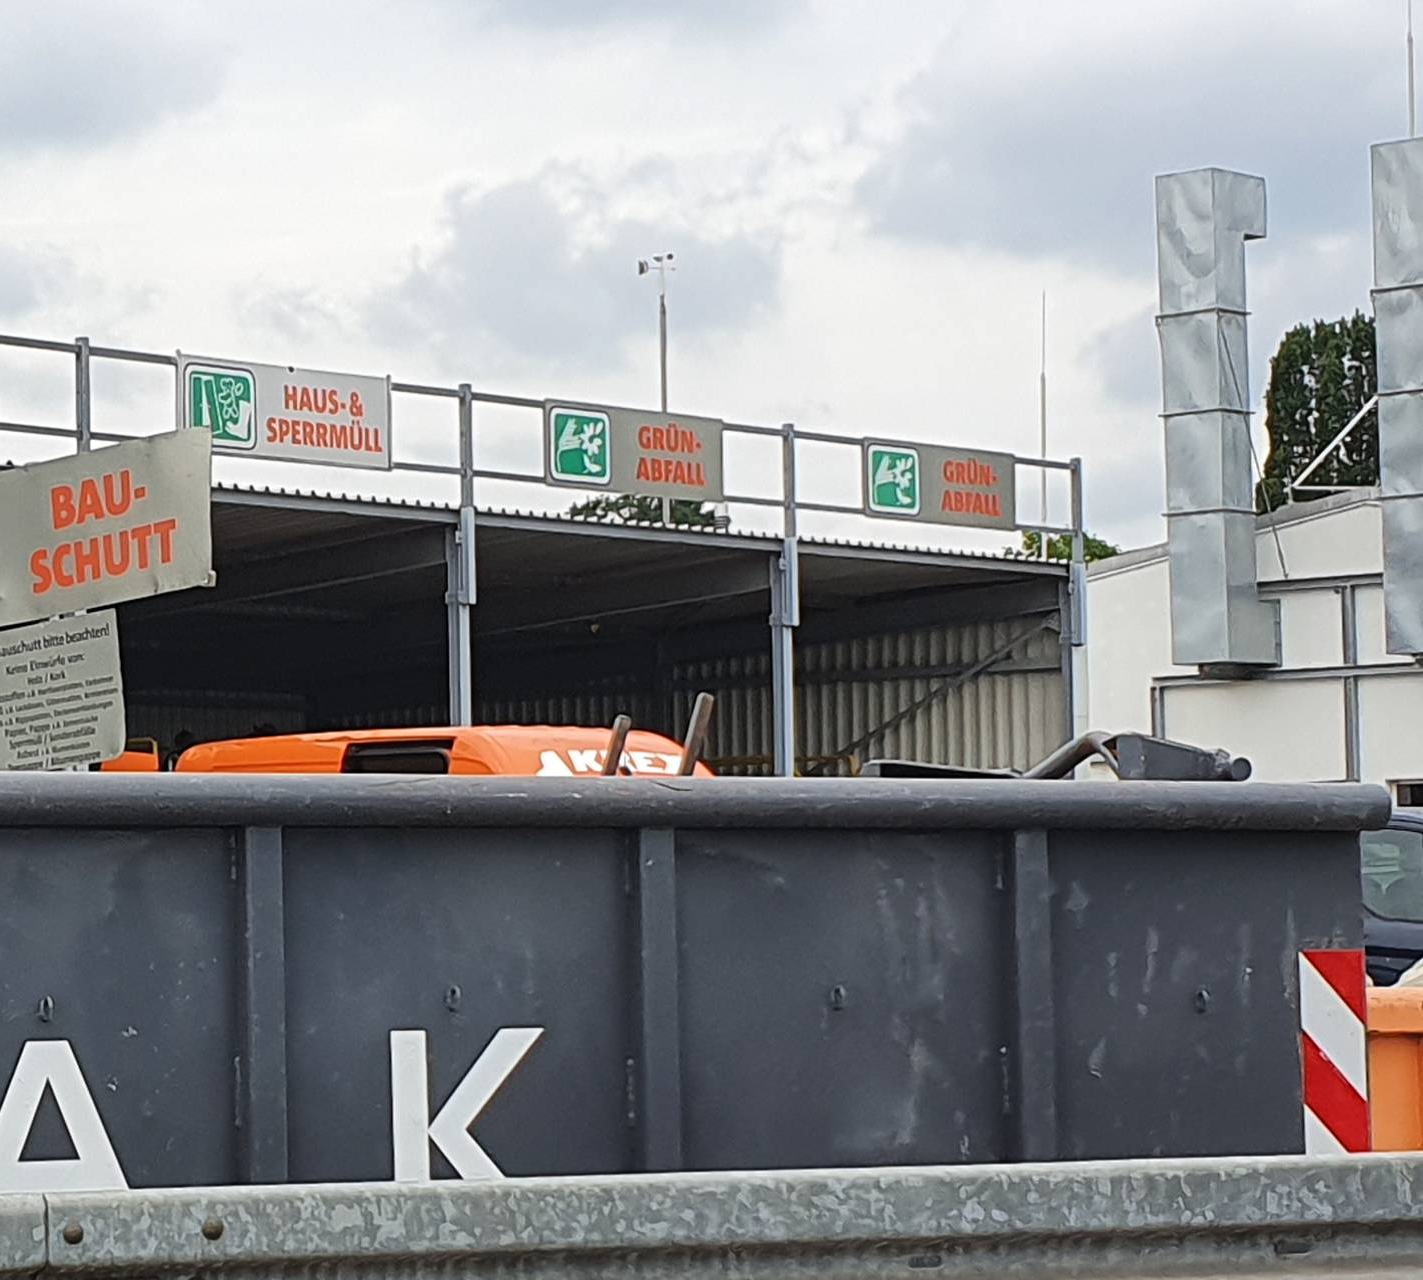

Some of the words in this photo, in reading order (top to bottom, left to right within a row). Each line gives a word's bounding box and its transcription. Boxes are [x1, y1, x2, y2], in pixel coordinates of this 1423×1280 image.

[267, 418, 383, 453] SPERRMÜLL
[638, 424, 702, 454] GRÜN-
[637, 457, 706, 487] ABFALL
[943, 458, 999, 487] GRÜN-
[50, 468, 147, 530] BAU-
[941, 490, 1003, 518] ABFALL
[30, 518, 178, 595] SCHUTT
[43, 634, 64, 648] bitte
[65, 622, 109, 644] beachten!
